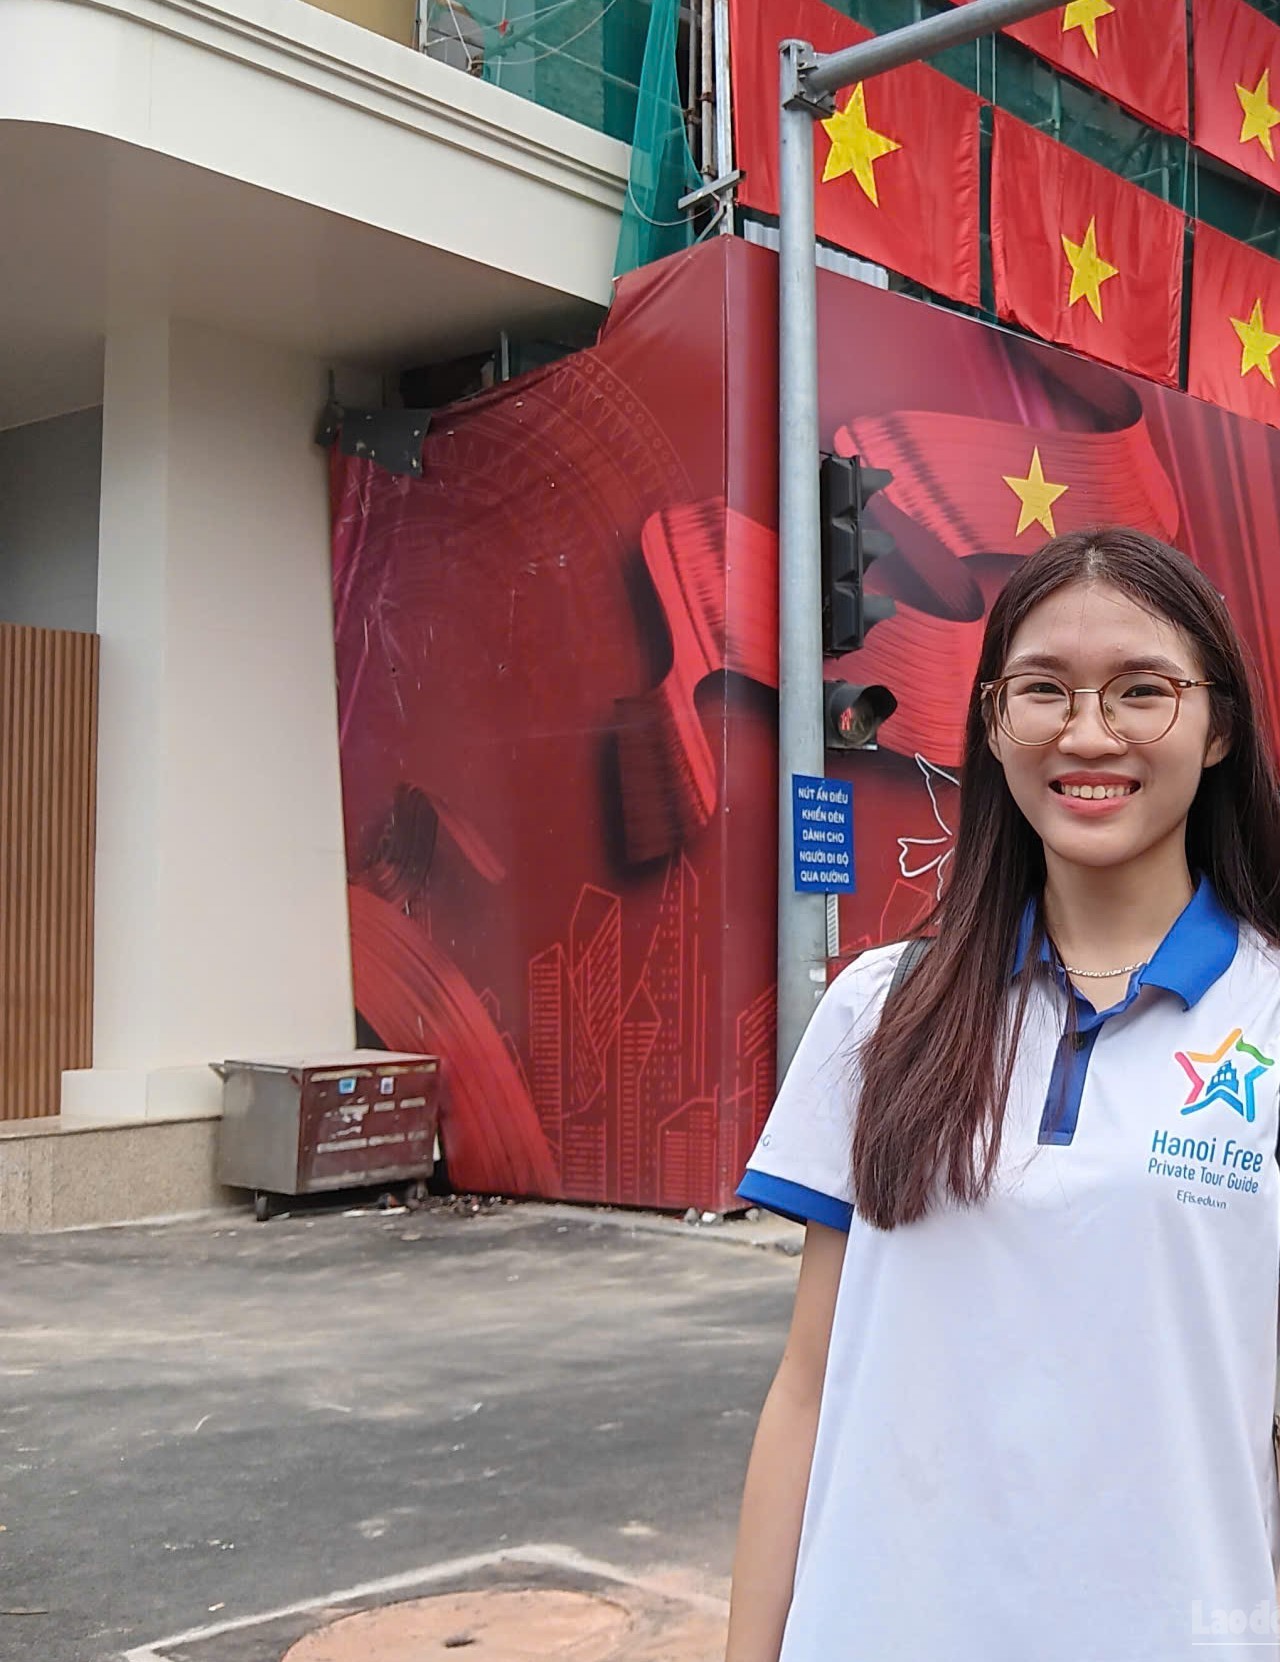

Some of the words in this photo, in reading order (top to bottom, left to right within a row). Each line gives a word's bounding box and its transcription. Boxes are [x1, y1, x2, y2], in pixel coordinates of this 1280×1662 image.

[826, 831, 845, 843] CHO
[800, 870, 820, 883] QUA
[1152, 1130, 1217, 1163] Hanoi
[1222, 1139, 1264, 1173] Free
[1148, 1157, 1196, 1181] Private
[1200, 1166, 1225, 1187] Tour
[1227, 1172, 1259, 1194] Guide
